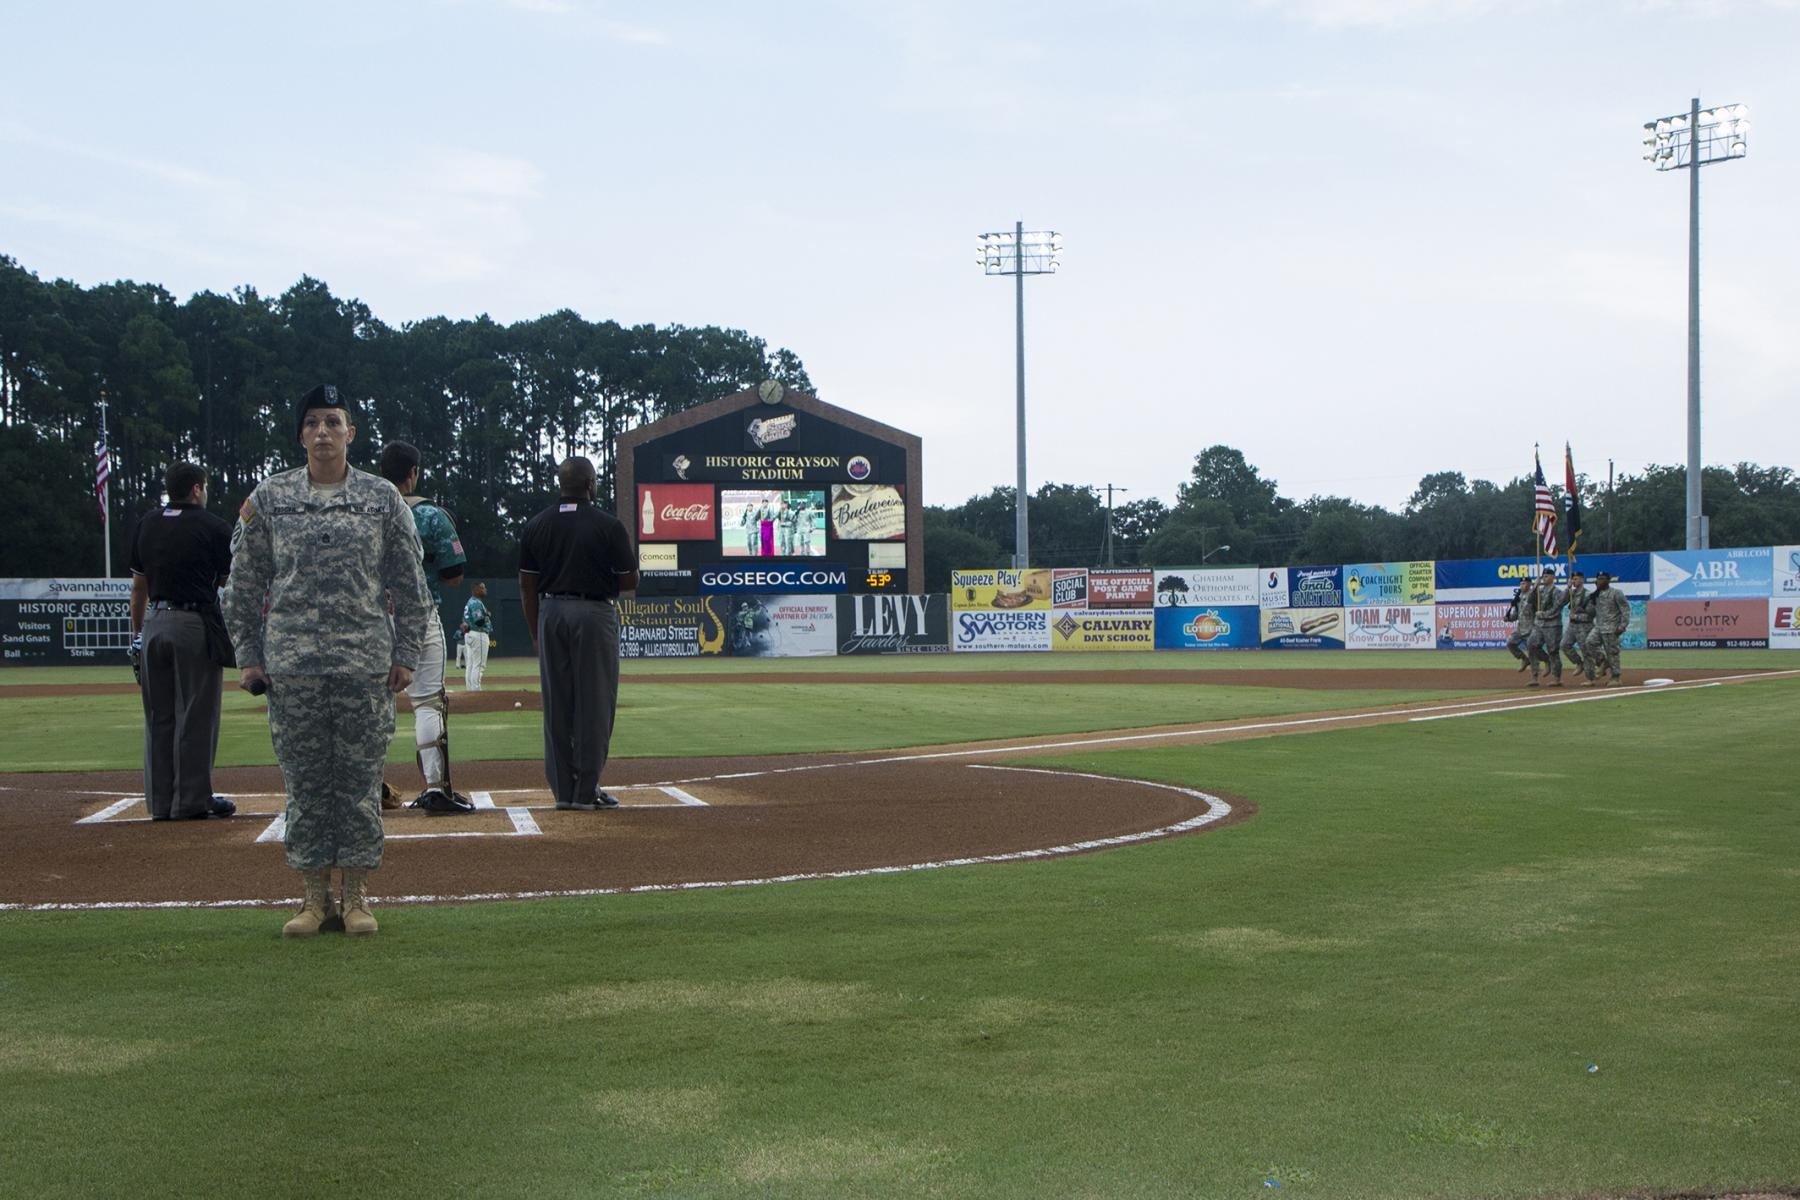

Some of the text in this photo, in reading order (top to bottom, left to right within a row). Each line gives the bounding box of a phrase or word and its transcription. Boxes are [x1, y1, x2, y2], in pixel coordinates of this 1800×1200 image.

[705, 456, 840, 468] HISTORIC GRAYSON
[742, 469, 804, 480] STADIUM
[660, 503, 711, 521] Coca-Cola
[642, 552, 676, 561] comcast
[1692, 561, 1740, 580] ABR
[701, 571, 847, 586] GOSEEOC.COM
[953, 570, 1022, 589] Squeeze Play!
[1090, 578, 1108, 586] THE
[1360, 575, 1403, 588] COACHLIGHT
[1055, 577, 1085, 593] SOCIAL
[1093, 585, 1118, 593] POST
[1379, 585, 1402, 597] TOURS
[1055, 589, 1077, 603] CLUB
[1105, 592, 1137, 600] PARTY
[1158, 593, 1188, 605] COA
[1262, 594, 1287, 602] MUSIC
[18, 602, 131, 613] HISTORIC GRAYSO
[615, 598, 705, 616] Alligator Soul
[1438, 606, 1480, 619] SUPERIOR
[621, 615, 697, 626] Restaurant
[853, 594, 932, 637] LEVY
[1348, 608, 1412, 625] 10AM 4PM
[18, 622, 51, 630] Visitors
[66, 620, 73, 631] 0
[964, 620, 1047, 635] MOTORS
[1082, 620, 1153, 631] CALVARY
[1186, 624, 1228, 633] LOTTERY
[1450, 620, 1480, 629] SERVICES
[1481, 620, 1489, 628] OF
[2, 634, 50, 643] Sand Gnats
[628, 626, 667, 641] BARNARD
[668, 625, 699, 640] STREET
[1083, 634, 1151, 642] DAY SCHOOL
[1348, 632, 1432, 644] Know Your Days?
[4, 649, 21, 658] Ball
[70, 648, 95, 657] Strike
[619, 642, 700, 657] 2-7899 ALLIGATORSOUL.COM
